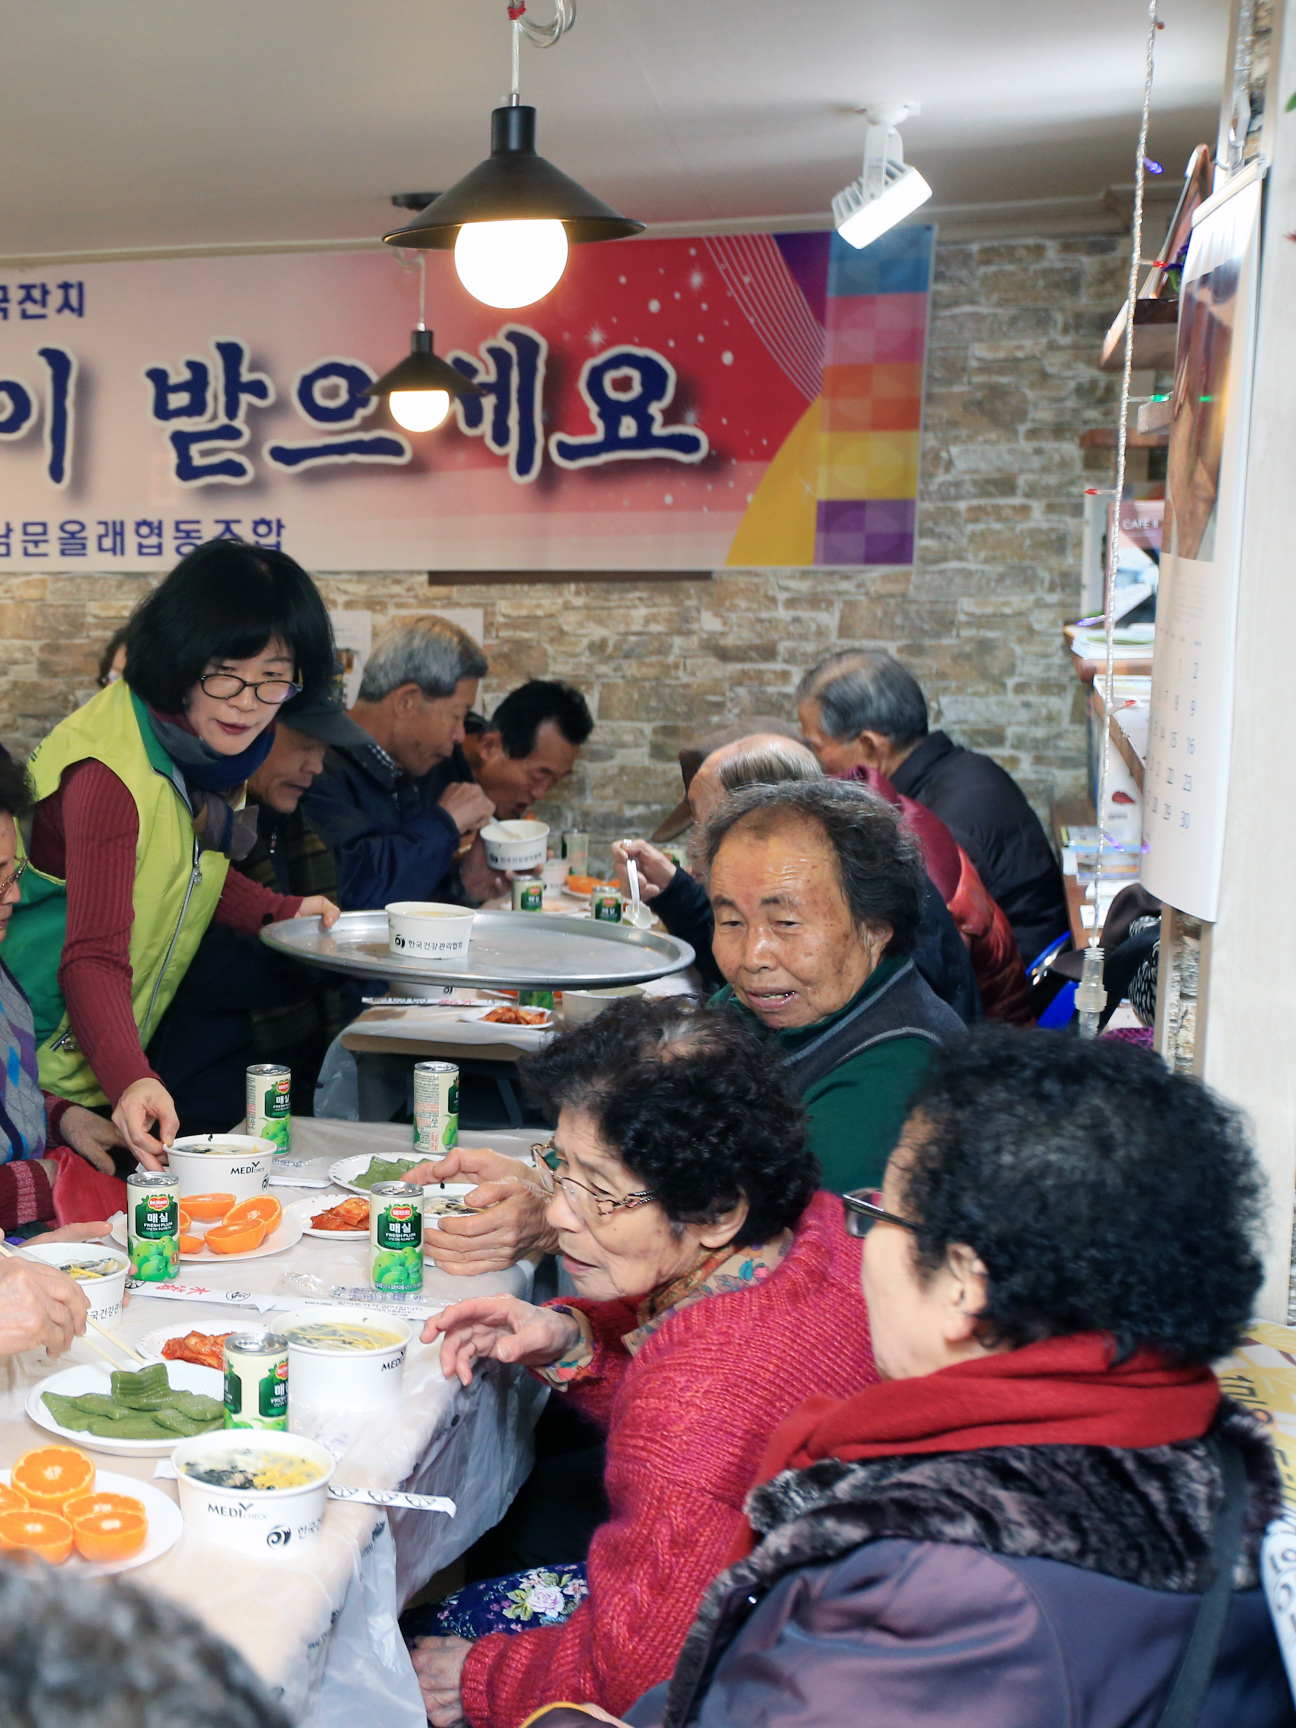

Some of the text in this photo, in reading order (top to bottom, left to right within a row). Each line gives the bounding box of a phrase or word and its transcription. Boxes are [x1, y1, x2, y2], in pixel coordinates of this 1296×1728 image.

[145, 329, 705, 481] 받으세요
[408, 939, 463, 951] 한국건강관리협회
[230, 1166, 254, 1175] MEDI
[147, 1212, 169, 1224] 매실
[389, 1222, 412, 1234] 매실
[207, 1503, 243, 1519] MEDI
